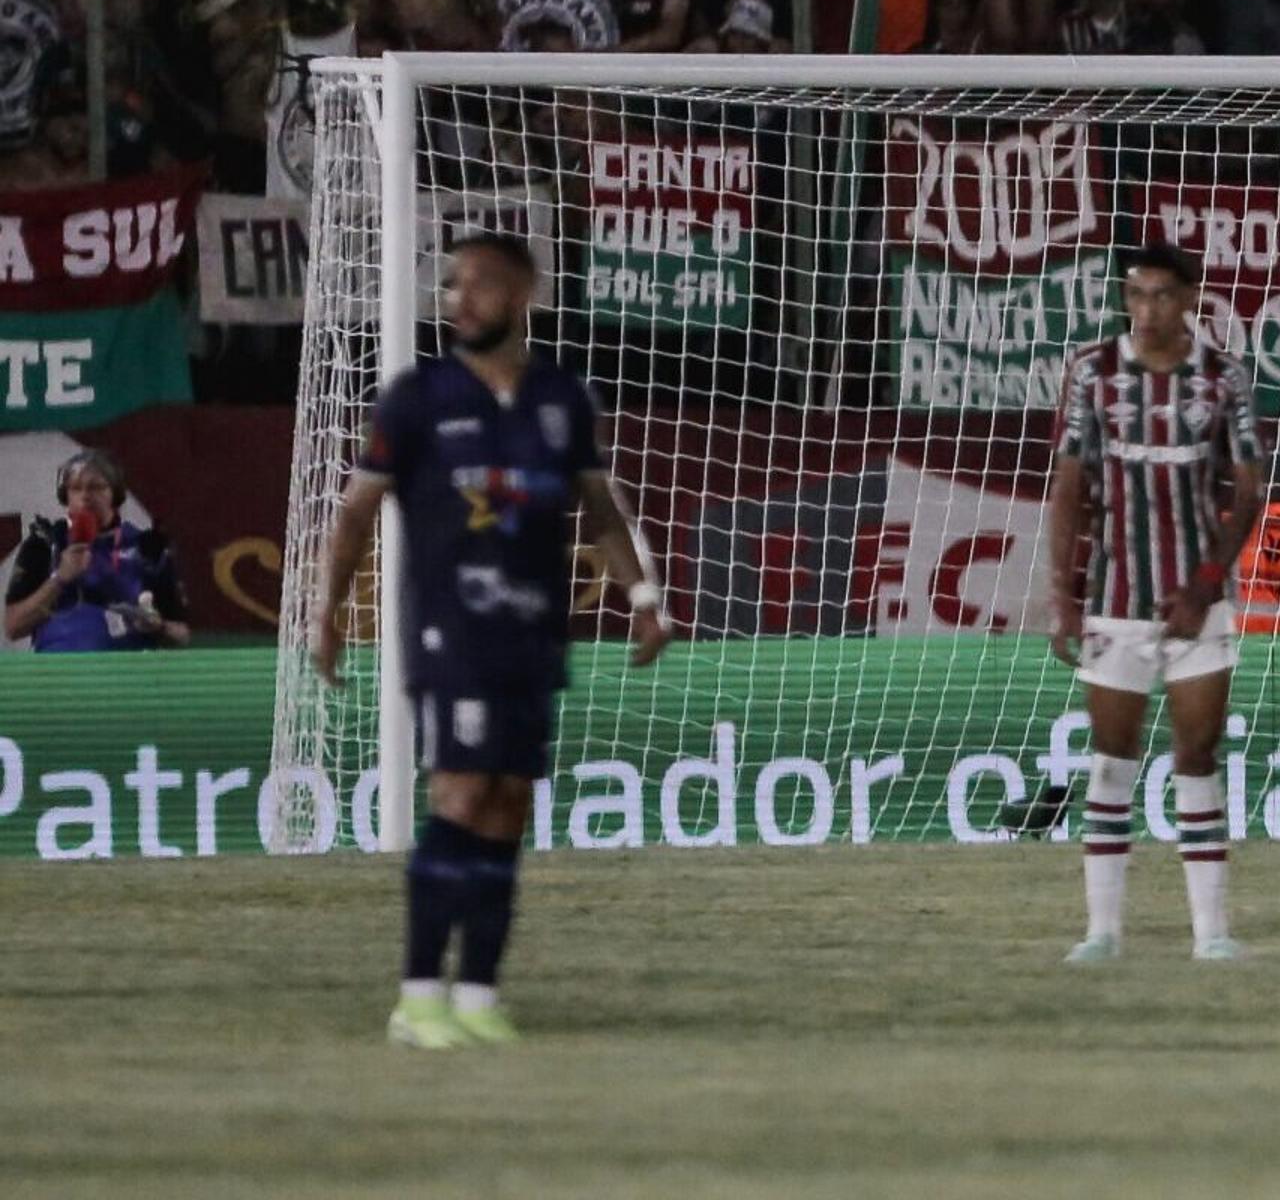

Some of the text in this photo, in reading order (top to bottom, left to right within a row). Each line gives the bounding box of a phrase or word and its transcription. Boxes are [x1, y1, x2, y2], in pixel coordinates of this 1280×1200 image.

[593, 143, 752, 193] CANTA
[893, 116, 1099, 263] 2009
[62, 197, 184, 279] SUL
[596, 205, 742, 255] QUE O
[585, 264, 737, 308] GOL SAI
[0, 717, 904, 862] atroador
